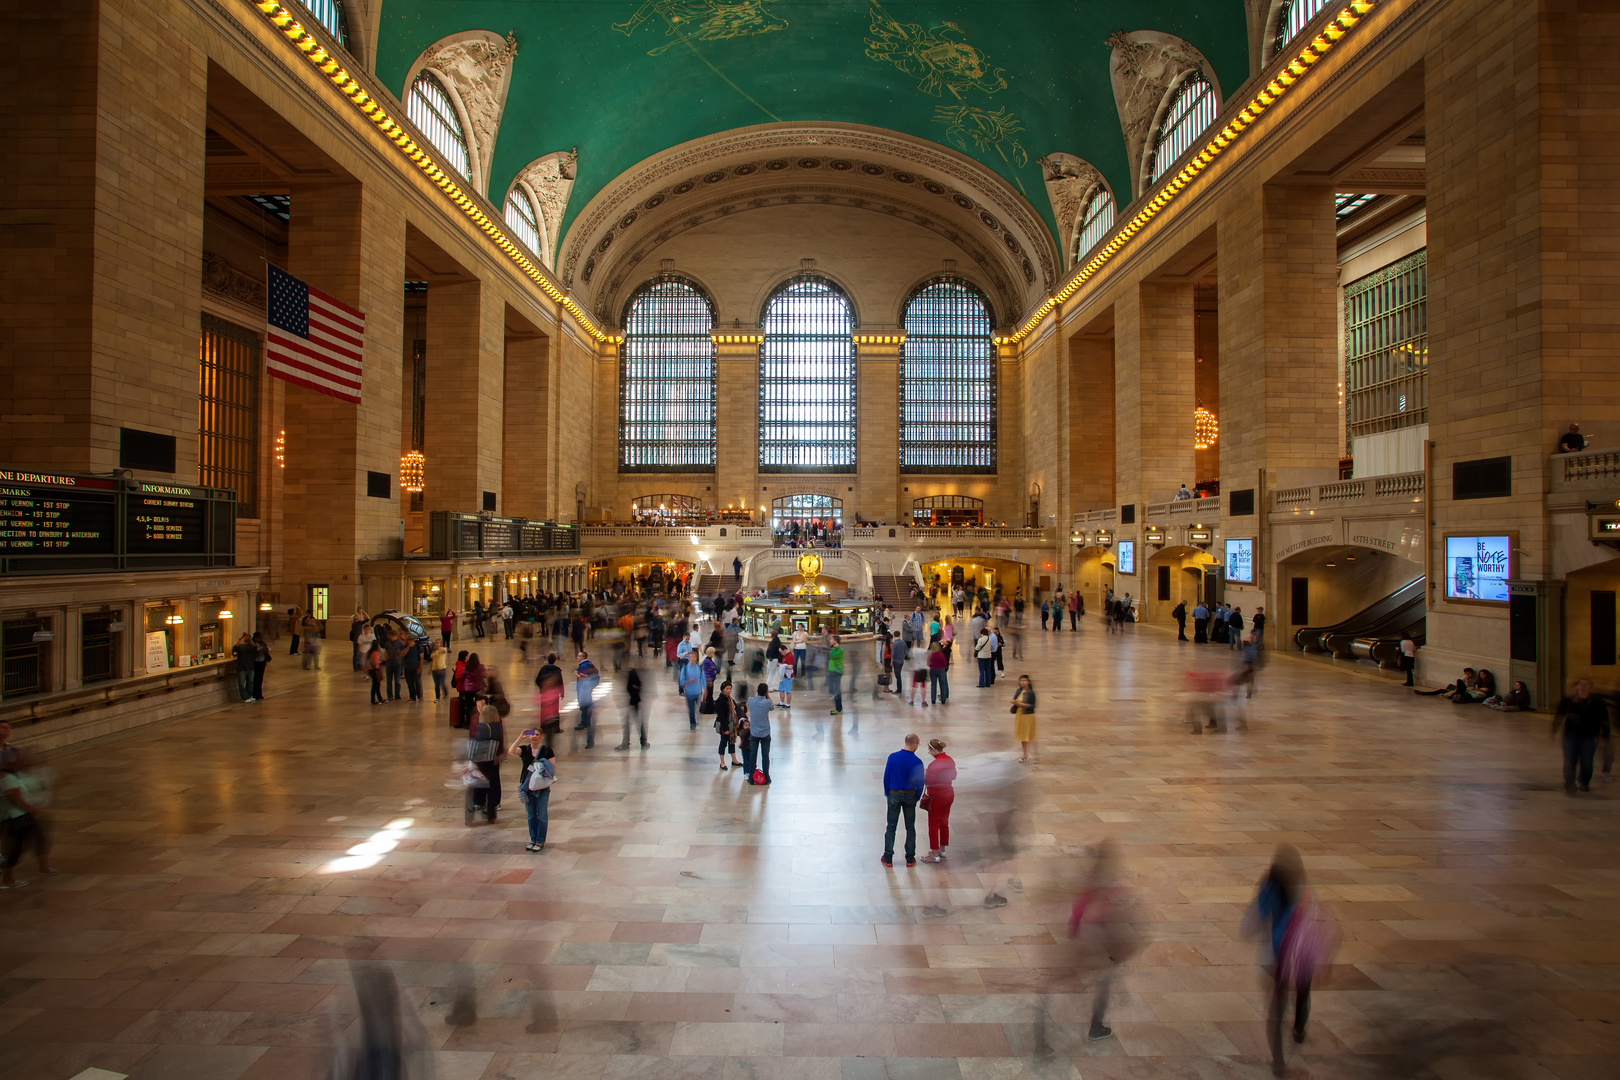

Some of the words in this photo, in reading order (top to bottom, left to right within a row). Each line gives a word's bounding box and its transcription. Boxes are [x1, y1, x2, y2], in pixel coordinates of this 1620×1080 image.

[16, 472, 76, 486] DEPARTURES
[142, 484, 191, 496] INFORMATION
[1276, 550, 1286, 560] THE
[1306, 534, 1332, 546] BUILDING
[1352, 536, 1368, 544] 45TH
[1370, 537, 1396, 550] STREET
[1478, 542, 1486, 550] BE
[1478, 550, 1508, 564] NOTE
[1478, 564, 1504, 573] WORTHY
